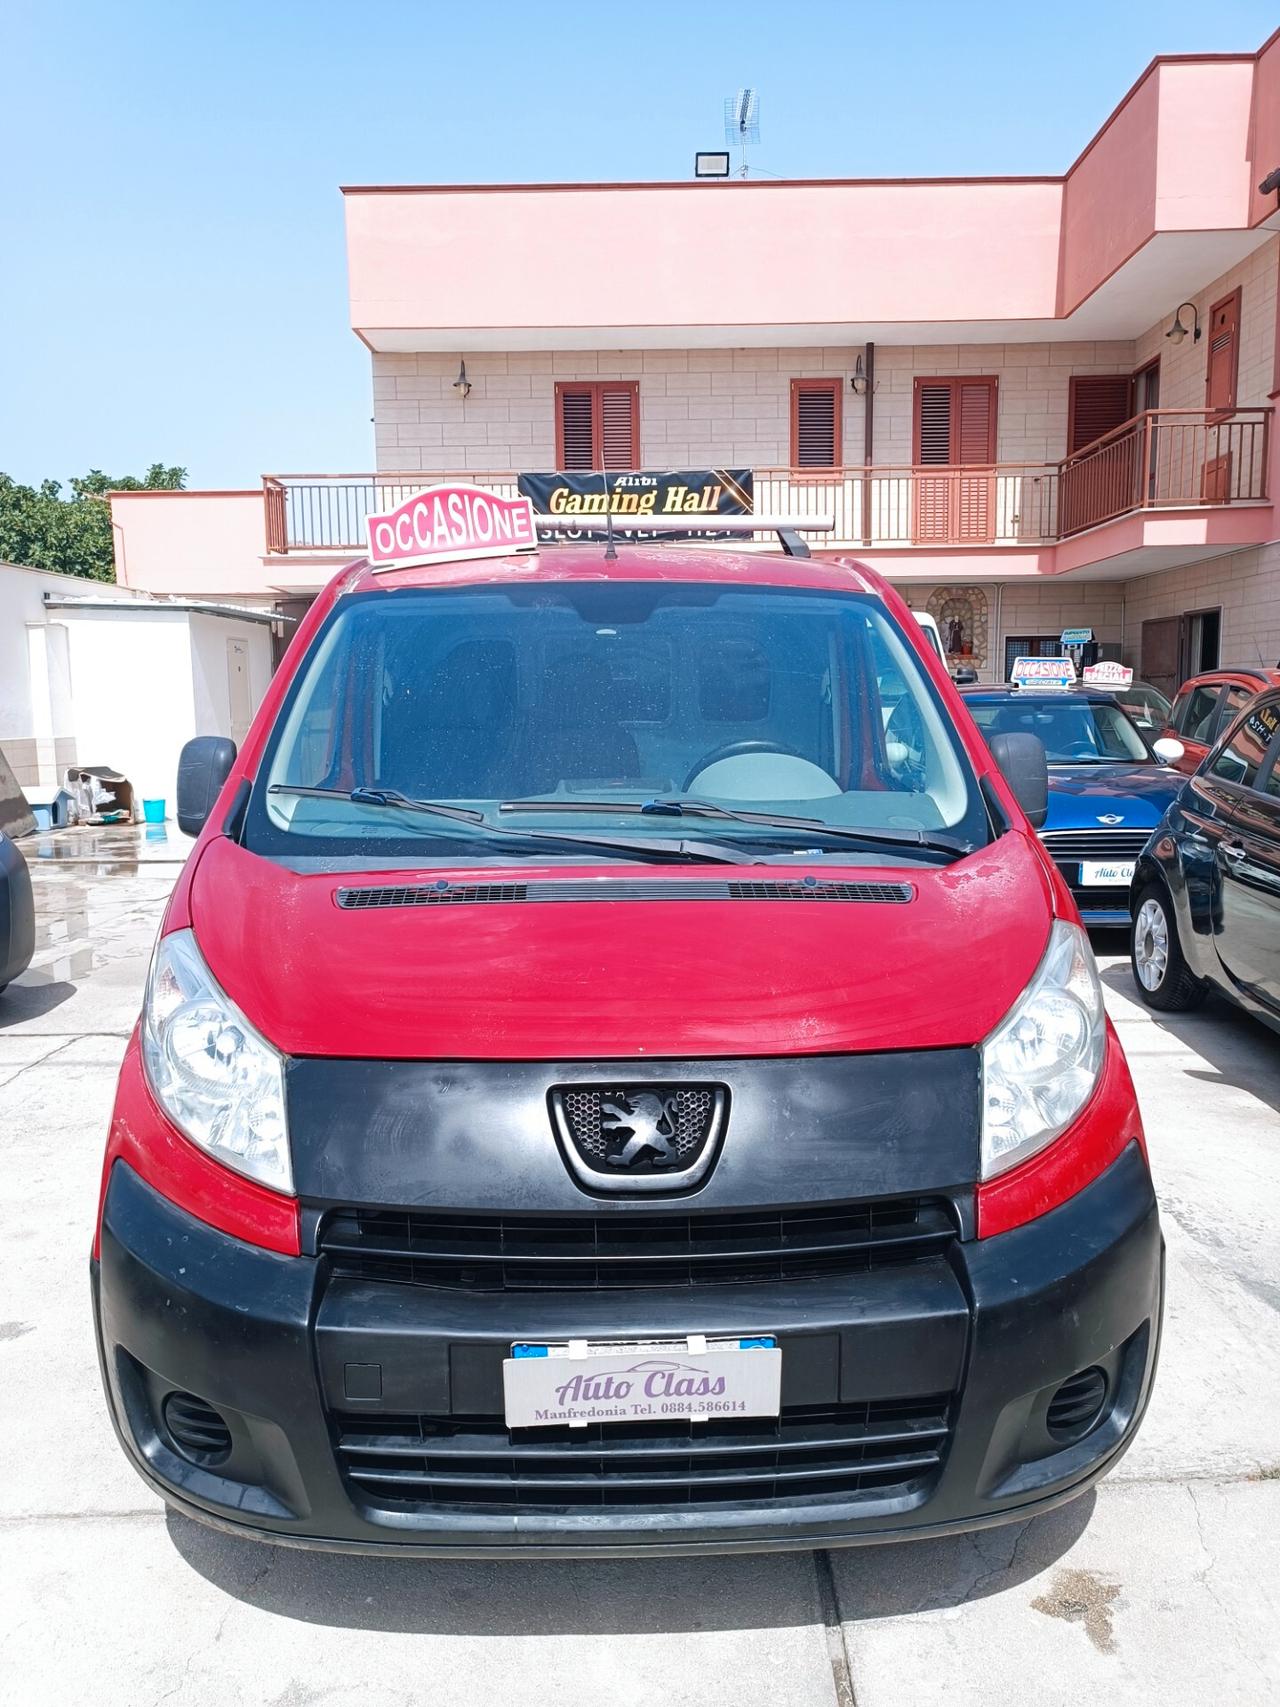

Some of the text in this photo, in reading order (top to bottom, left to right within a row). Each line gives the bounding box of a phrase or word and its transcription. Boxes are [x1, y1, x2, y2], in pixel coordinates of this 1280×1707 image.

[613, 476, 658, 486] Alibi
[549, 485, 721, 515] Gaming Hall
[375, 493, 529, 553] OCCASIONE
[1015, 661, 1073, 677] OCCASIONE
[1094, 663, 1122, 672] PREZZO
[1085, 671, 1132, 681] SPECIALE
[1094, 868, 1118, 879] Auto
[555, 1371, 726, 1405] Auto Class
[535, 1400, 746, 1420] Manfredonia Tel. 0884.586614
